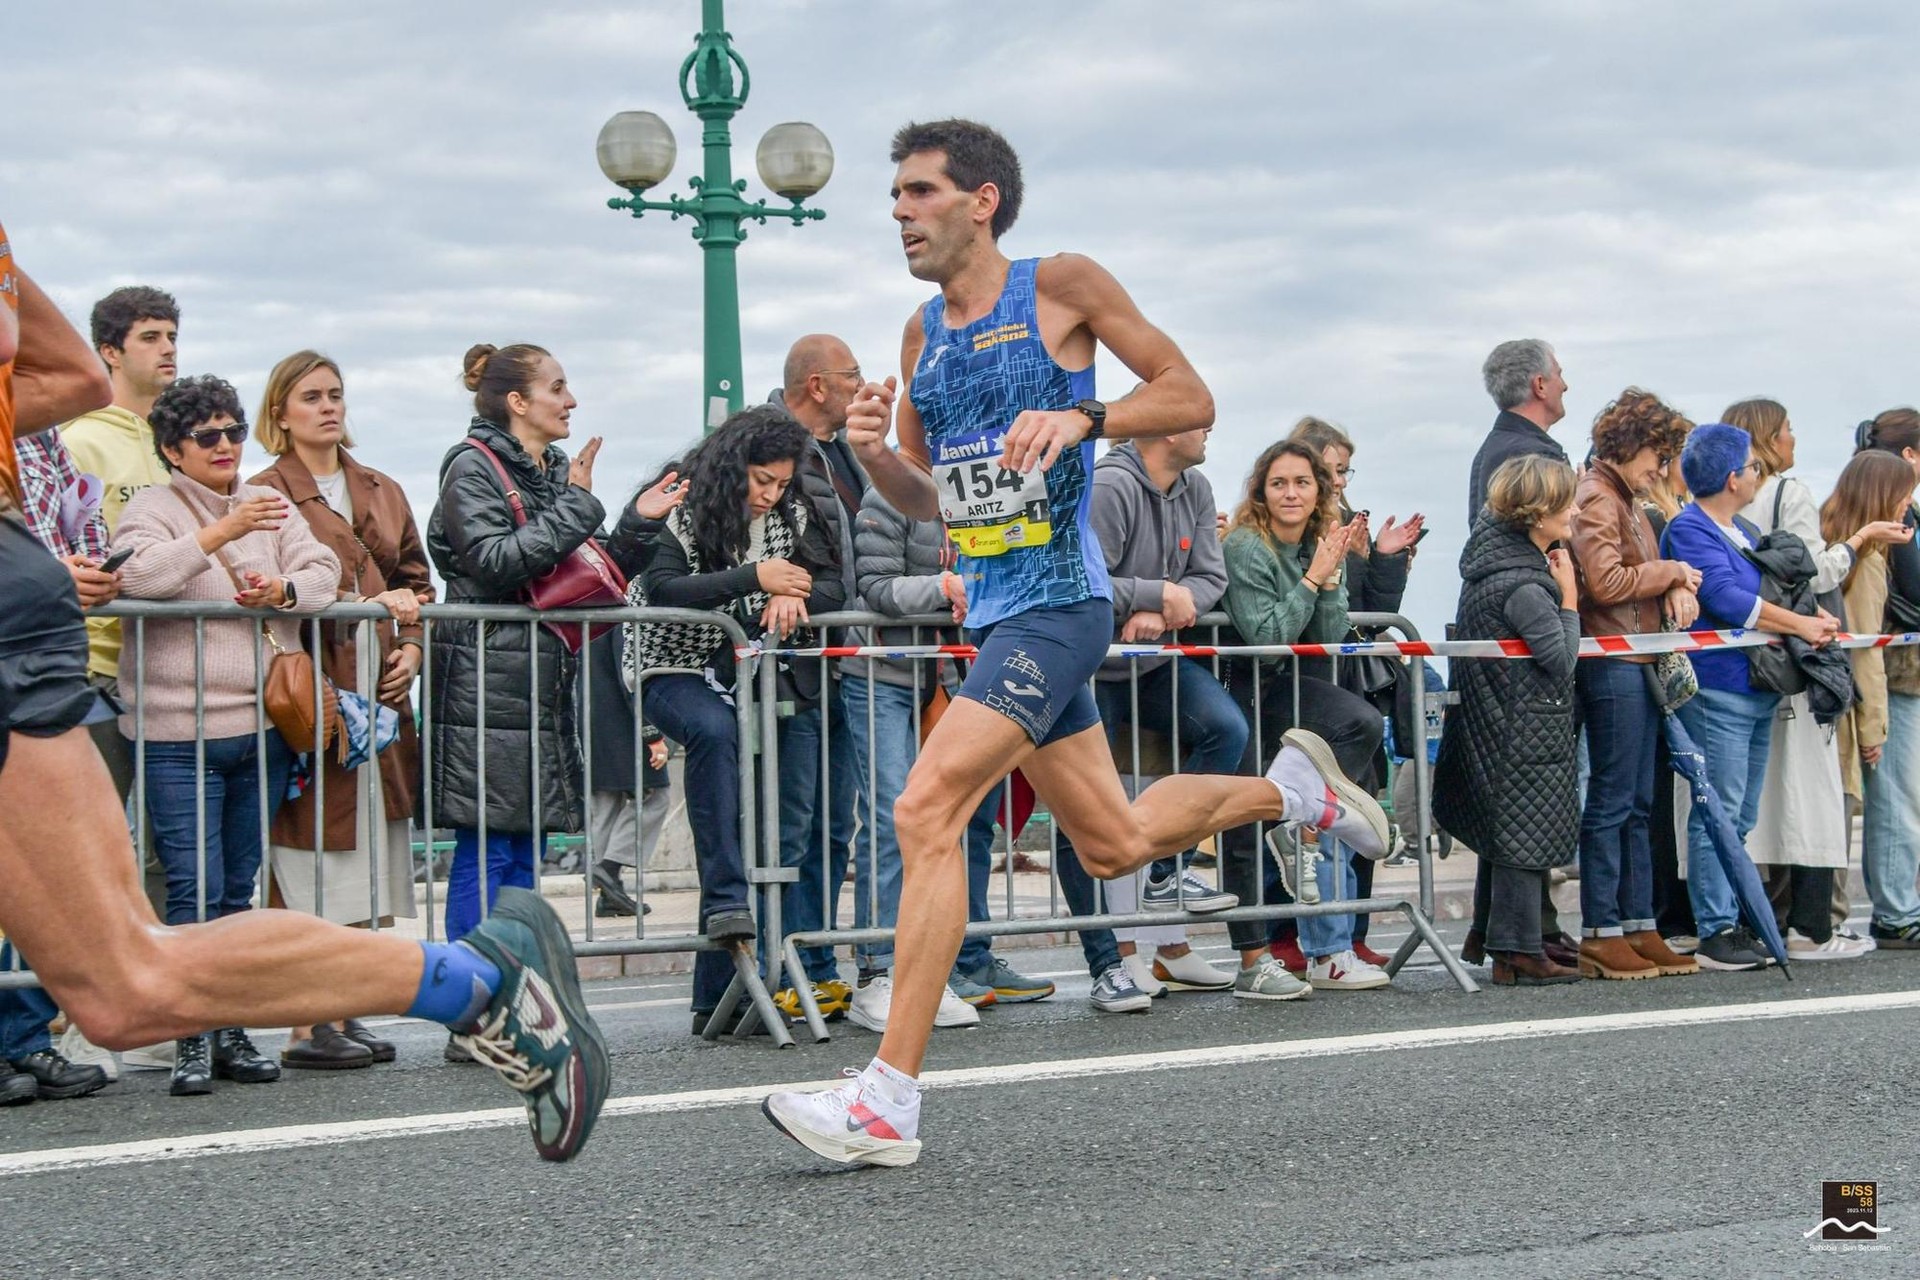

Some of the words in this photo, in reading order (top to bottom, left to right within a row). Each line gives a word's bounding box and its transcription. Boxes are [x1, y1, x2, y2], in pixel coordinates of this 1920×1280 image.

[946, 462, 1024, 501] 154
[968, 501, 1004, 517] ARITZ
[1033, 502, 1042, 520] 1
